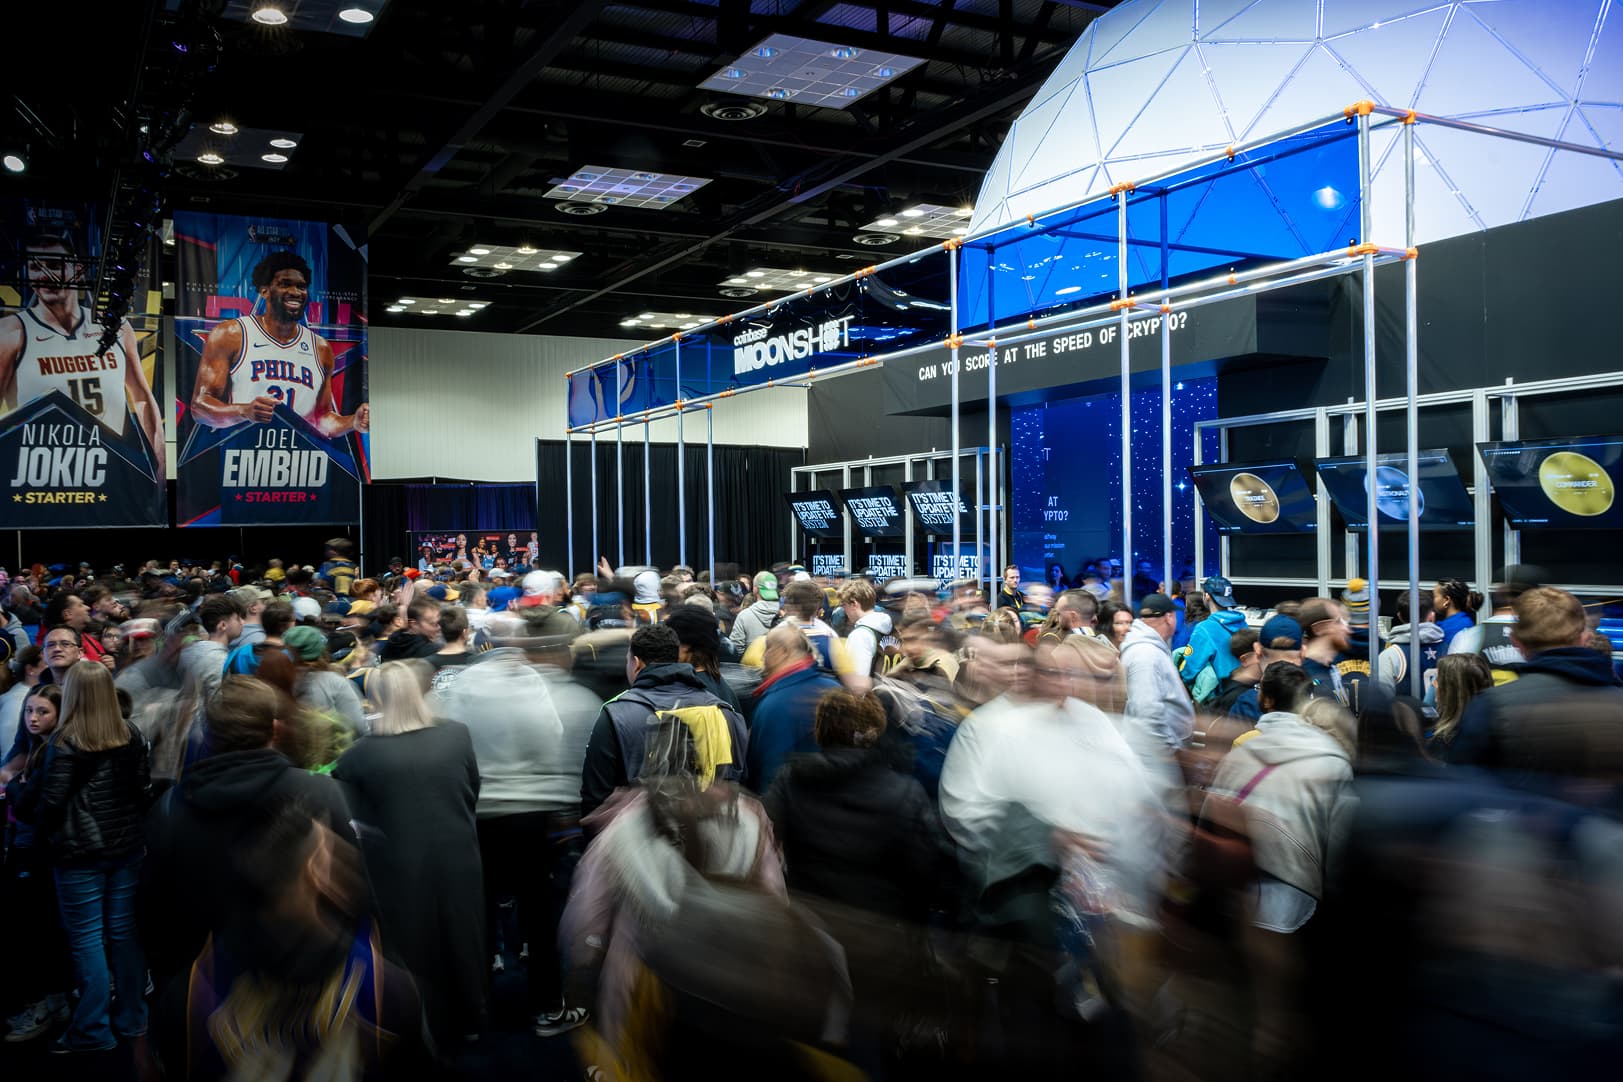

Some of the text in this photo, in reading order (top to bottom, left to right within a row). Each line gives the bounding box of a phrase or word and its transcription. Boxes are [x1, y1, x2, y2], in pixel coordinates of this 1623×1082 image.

[733, 327, 768, 346] coinbase
[918, 365, 937, 381] CAN
[1004, 347, 1019, 364] AT
[1024, 341, 1047, 359] THE
[1053, 332, 1092, 354] SPEED
[1099, 327, 1117, 344] OF
[1126, 312, 1187, 339] CRYPO?
[250, 359, 314, 390] PHILA
[67, 377, 104, 416] 15
[21, 423, 101, 446] NIKOLA
[254, 428, 298, 449] JOEL
[10, 446, 108, 488] JOKIC
[222, 450, 329, 488] EMBIID
[25, 492, 95, 504] STARTER
[245, 491, 308, 503] STARTER
[862, 497, 882, 508] TIME
[880, 496, 892, 507] TO
[911, 492, 929, 503] IT'S
[926, 492, 949, 503] TIME
[1048, 496, 1058, 507] AT
[852, 506, 899, 518] UPDATE THE
[916, 502, 968, 513] UPDATE TE
[823, 509, 837, 519] THE
[813, 555, 825, 565] IT'S
[825, 555, 840, 565] TIME
[869, 555, 882, 566] IT'S
[882, 555, 899, 566] TIME
[933, 555, 949, 566] IT'S
[813, 566, 842, 575] UPDAT
[896, 566, 907, 577] TH
[933, 567, 978, 579] UPDAE TH
